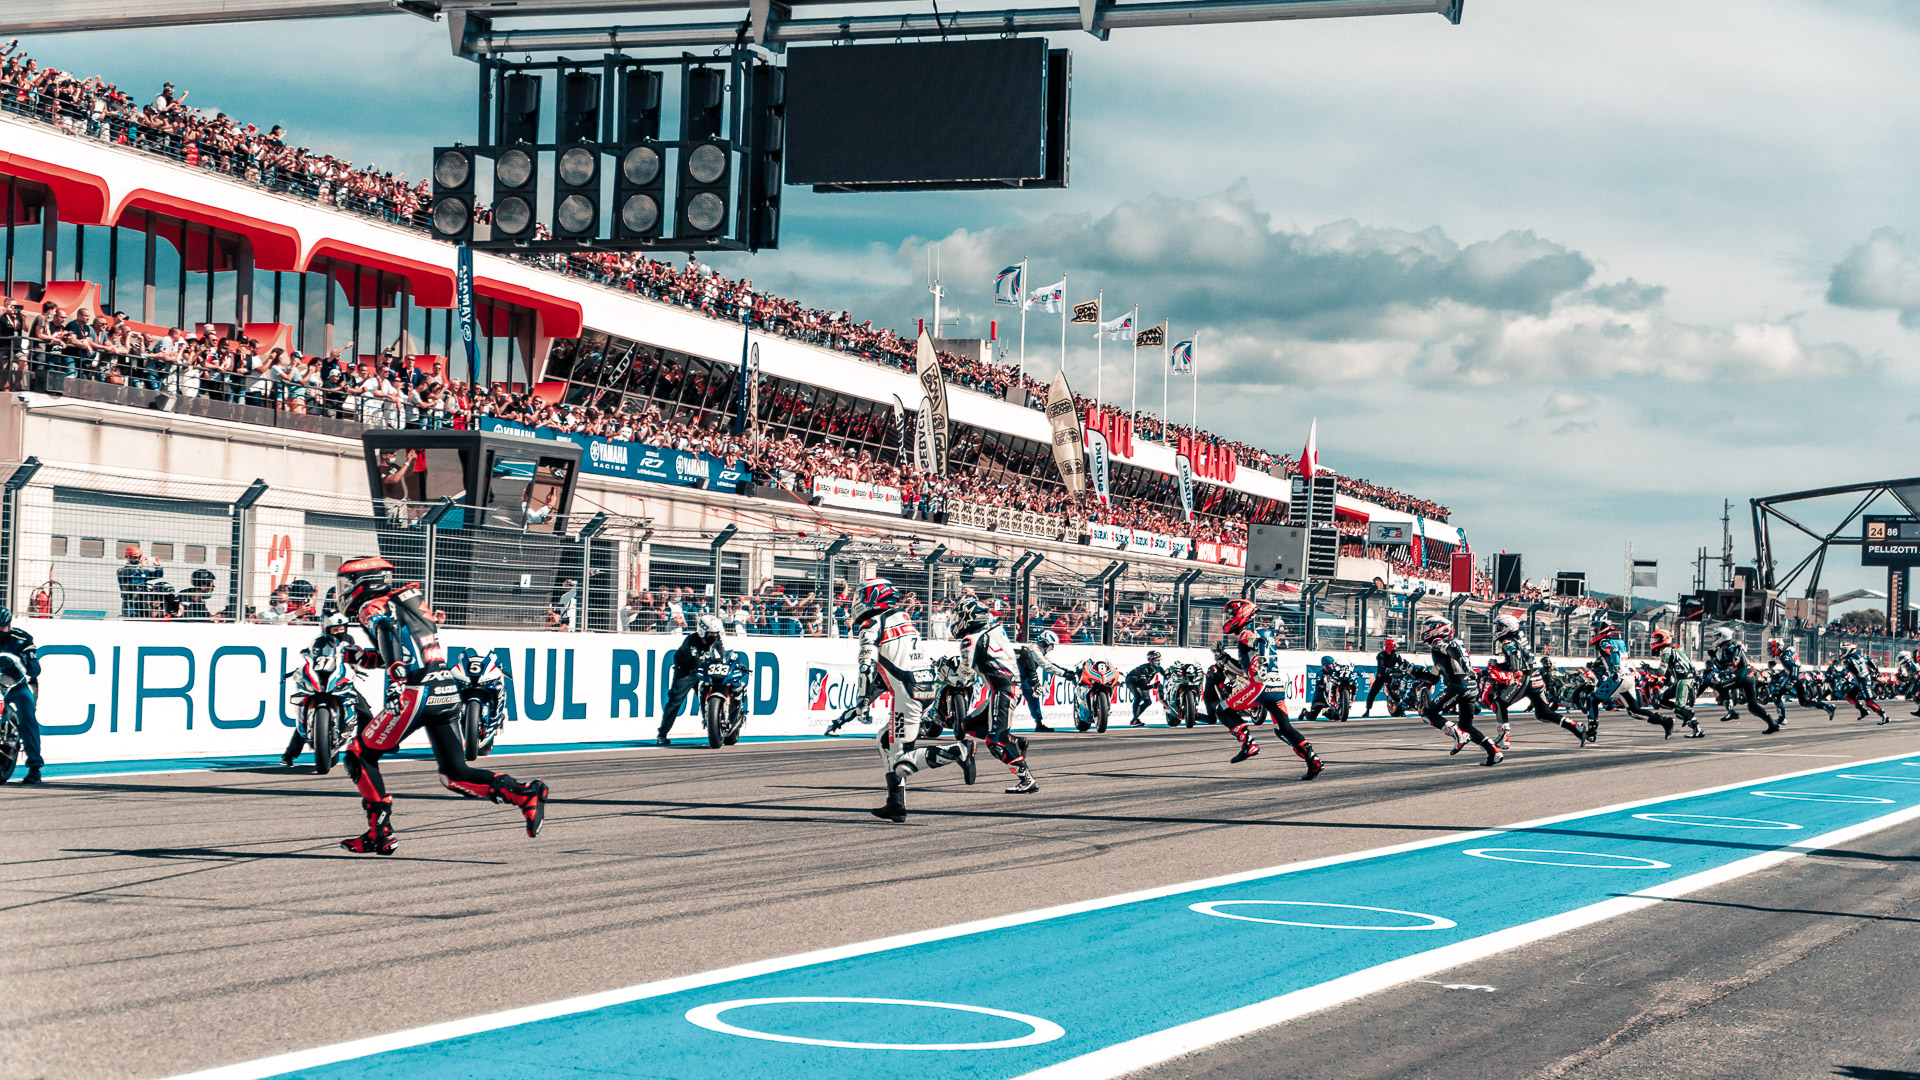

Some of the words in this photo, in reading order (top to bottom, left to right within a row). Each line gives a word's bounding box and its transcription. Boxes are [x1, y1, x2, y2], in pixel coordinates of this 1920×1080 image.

[1085, 408, 1134, 458] PAUL
[599, 443, 628, 464] YAMAHA
[1176, 436, 1237, 483] RICARD
[593, 462, 626, 472] RACING
[683, 457, 710, 478] YAMAHA
[1871, 528, 1882, 536] 24
[1887, 528, 1898, 536] 86
[1868, 546, 1918, 554] PELLIZOTTI
[911, 638, 918, 650] 7
[314, 656, 336, 670] 37
[469, 662, 482, 673] 5
[708, 664, 730, 676] 333
[1186, 665, 1195, 674] 4
[37, 644, 396, 735] CIRCU
[611, 648, 779, 718] RICD
[828, 672, 860, 710] clu
[1055, 678, 1076, 705] clu
[1232, 687, 1257, 708] IXON
[364, 706, 394, 738] SUZ
